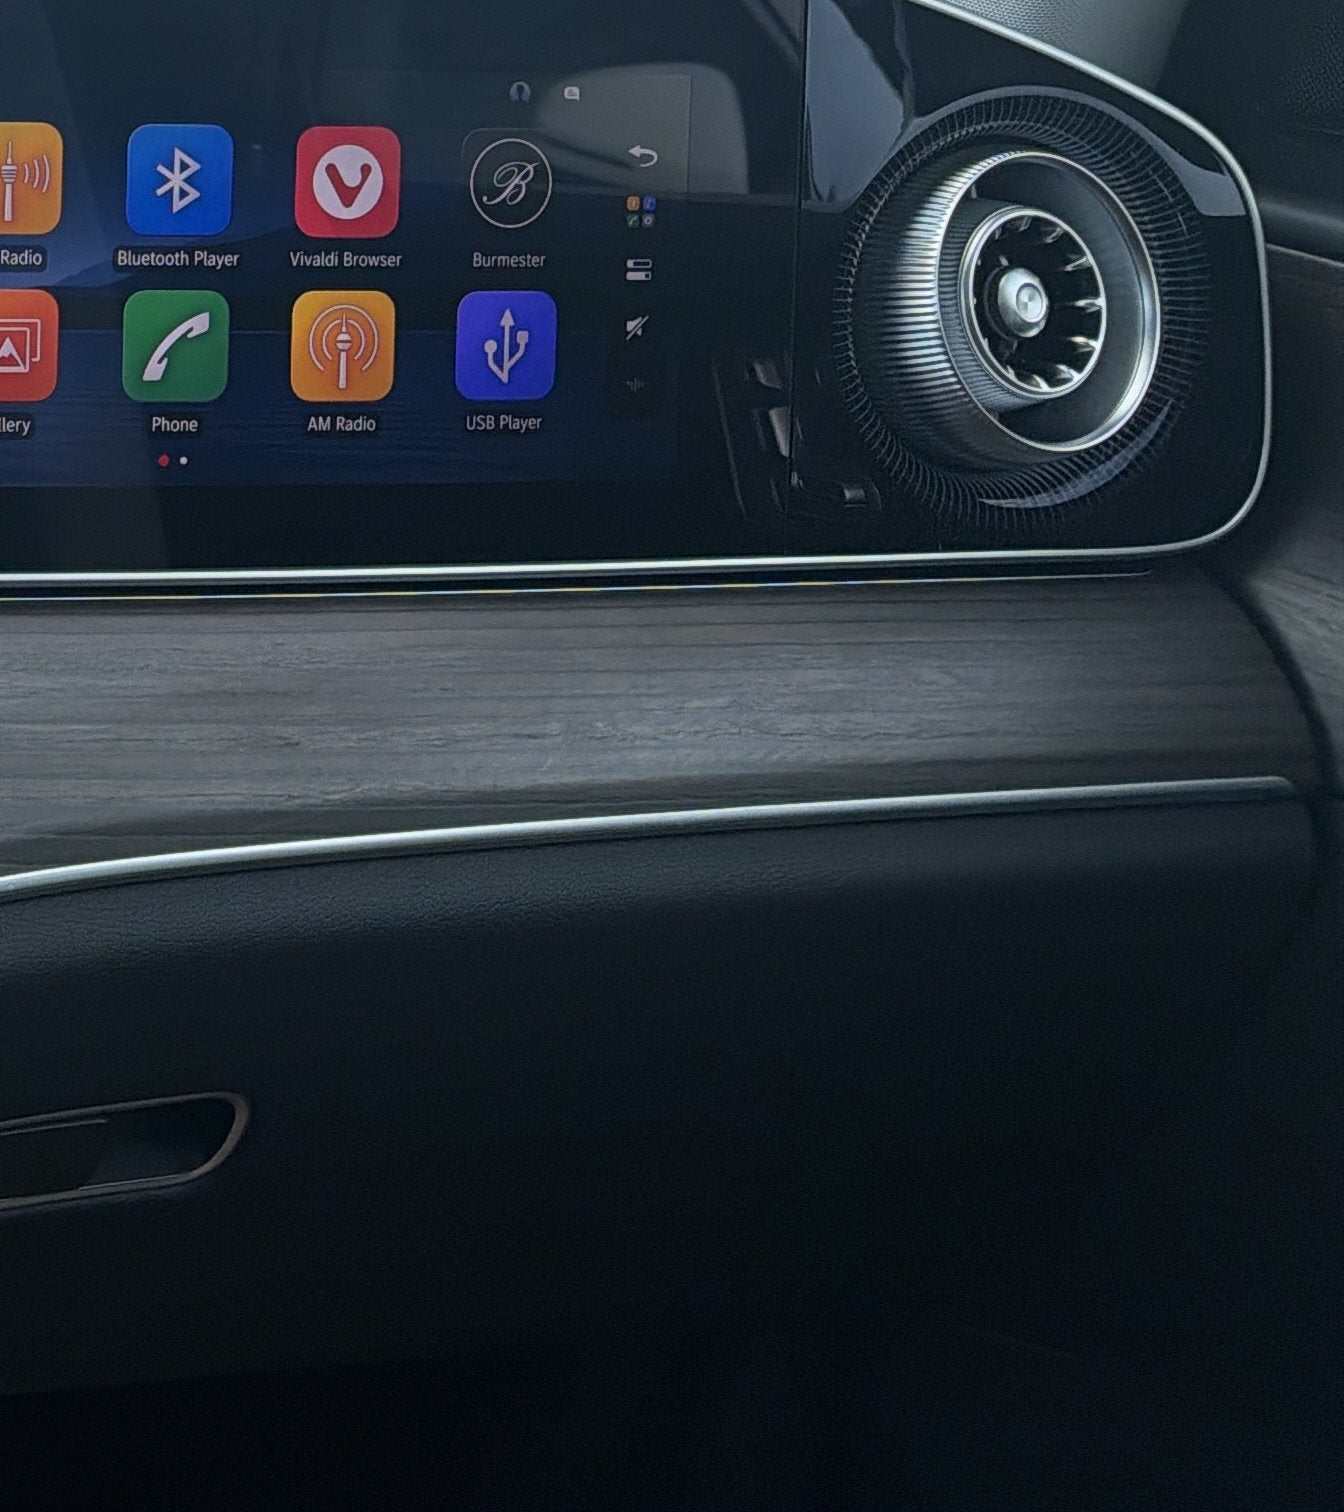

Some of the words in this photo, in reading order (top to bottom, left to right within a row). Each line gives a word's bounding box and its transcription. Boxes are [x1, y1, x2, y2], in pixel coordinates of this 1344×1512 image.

[0, 249, 43, 267] Radio
[117, 249, 189, 268] Bluetooth
[193, 250, 240, 272] Player
[289, 250, 339, 269] Vivaldi
[343, 251, 403, 269] Browser
[472, 251, 547, 269] Burmester
[151, 415, 199, 434] Phone
[307, 416, 331, 433] AM
[335, 415, 377, 433] Radio
[466, 413, 494, 431] USB
[499, 413, 543, 437] Player
